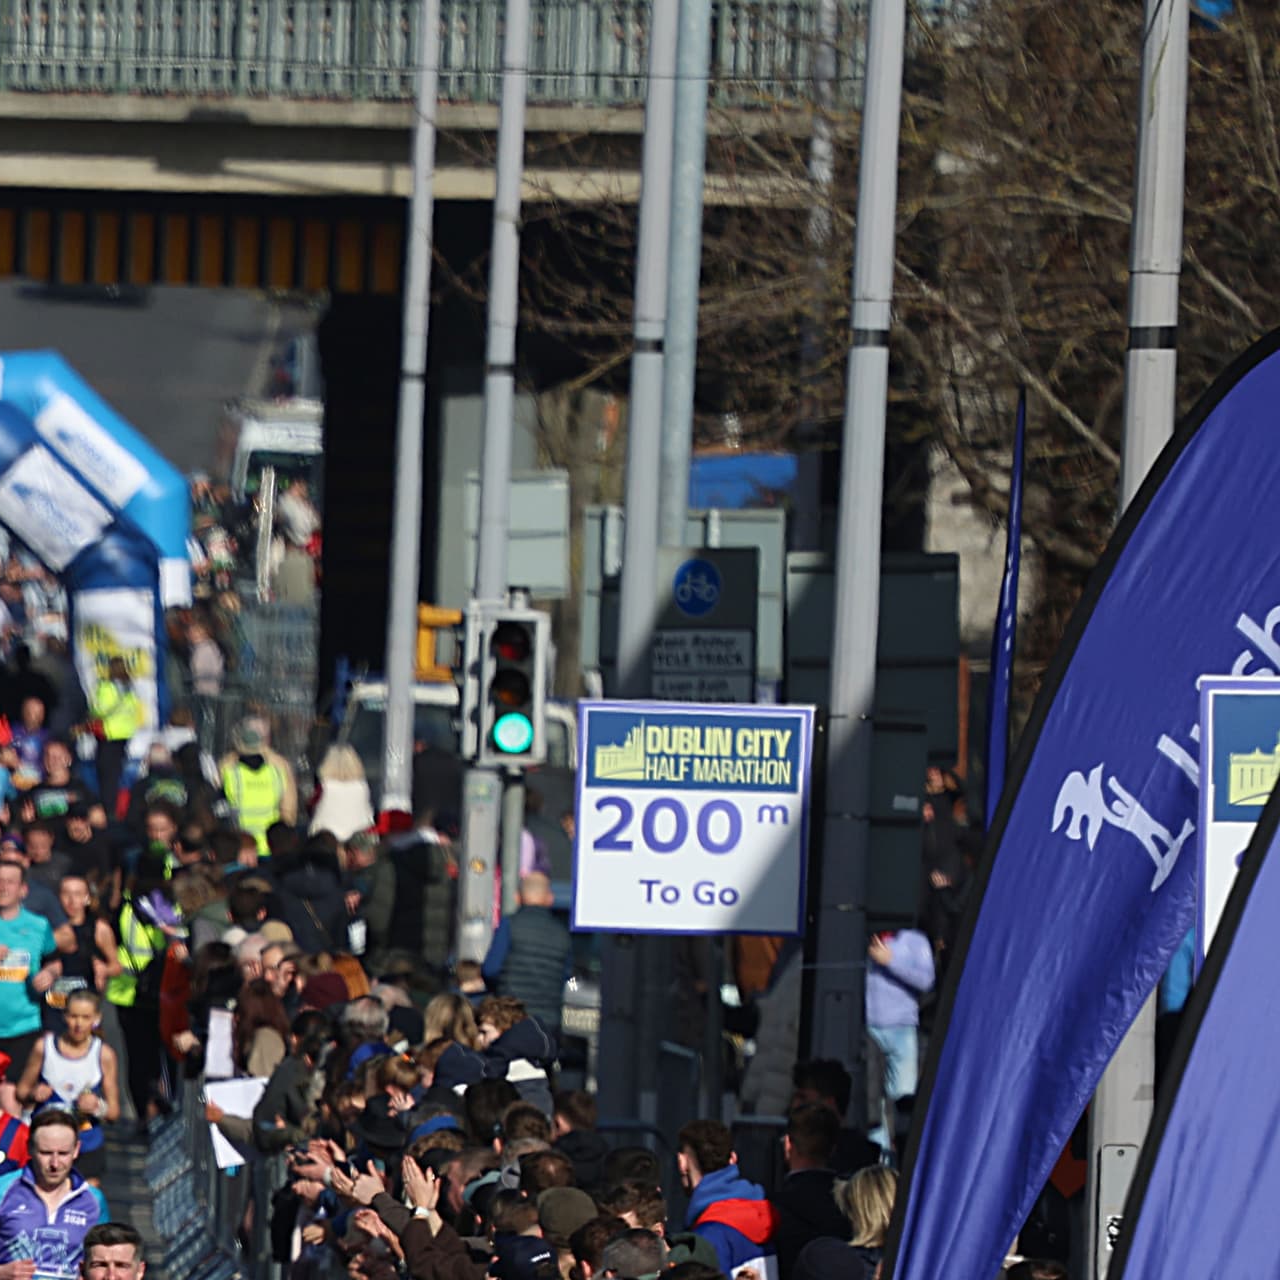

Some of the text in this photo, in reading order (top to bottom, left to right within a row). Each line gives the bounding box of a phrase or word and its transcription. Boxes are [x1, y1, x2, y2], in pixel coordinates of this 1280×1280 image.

[646, 725, 792, 758] DUBLIN CITY
[646, 756, 791, 784] HALF MARATHON
[592, 795, 789, 854] 200 m
[638, 878, 740, 907] To Go
